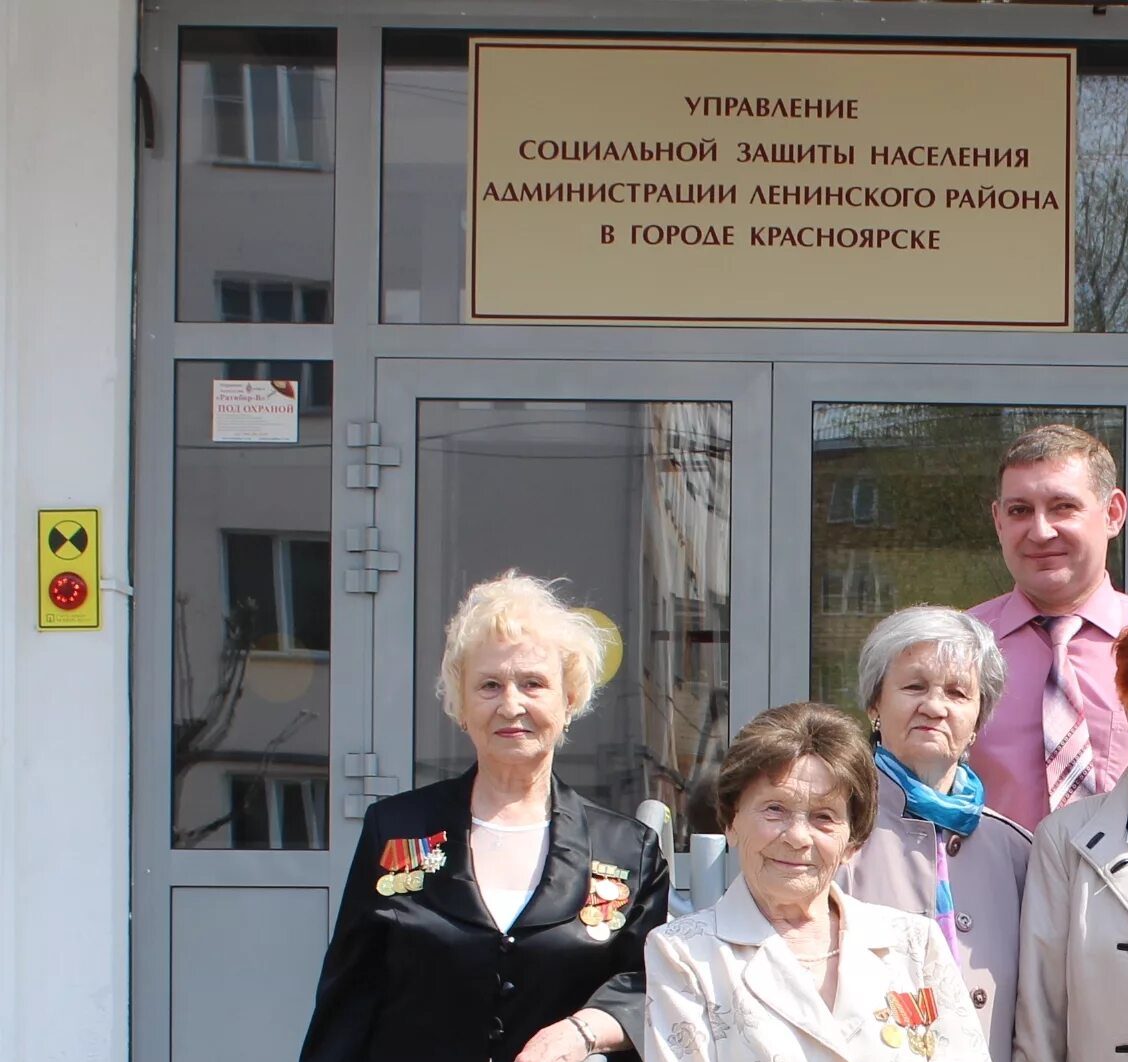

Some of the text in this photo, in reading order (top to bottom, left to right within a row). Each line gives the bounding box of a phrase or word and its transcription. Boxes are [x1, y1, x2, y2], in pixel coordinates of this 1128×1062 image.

[684, 96, 859, 120] УПРАВЛЕНИЕ
[518, 138, 1029, 168] СОЦИАЛЬНОЙ ЗАЩИТЫ НАСЕЛЕНИЯ
[482, 181, 1060, 210] АДМИНИСТРАЦИИ ЛЕНИНСКОГО РАЙОНА
[600, 224, 941, 250] В ГОРОДЕ КРАСНОЯРСКЕ
